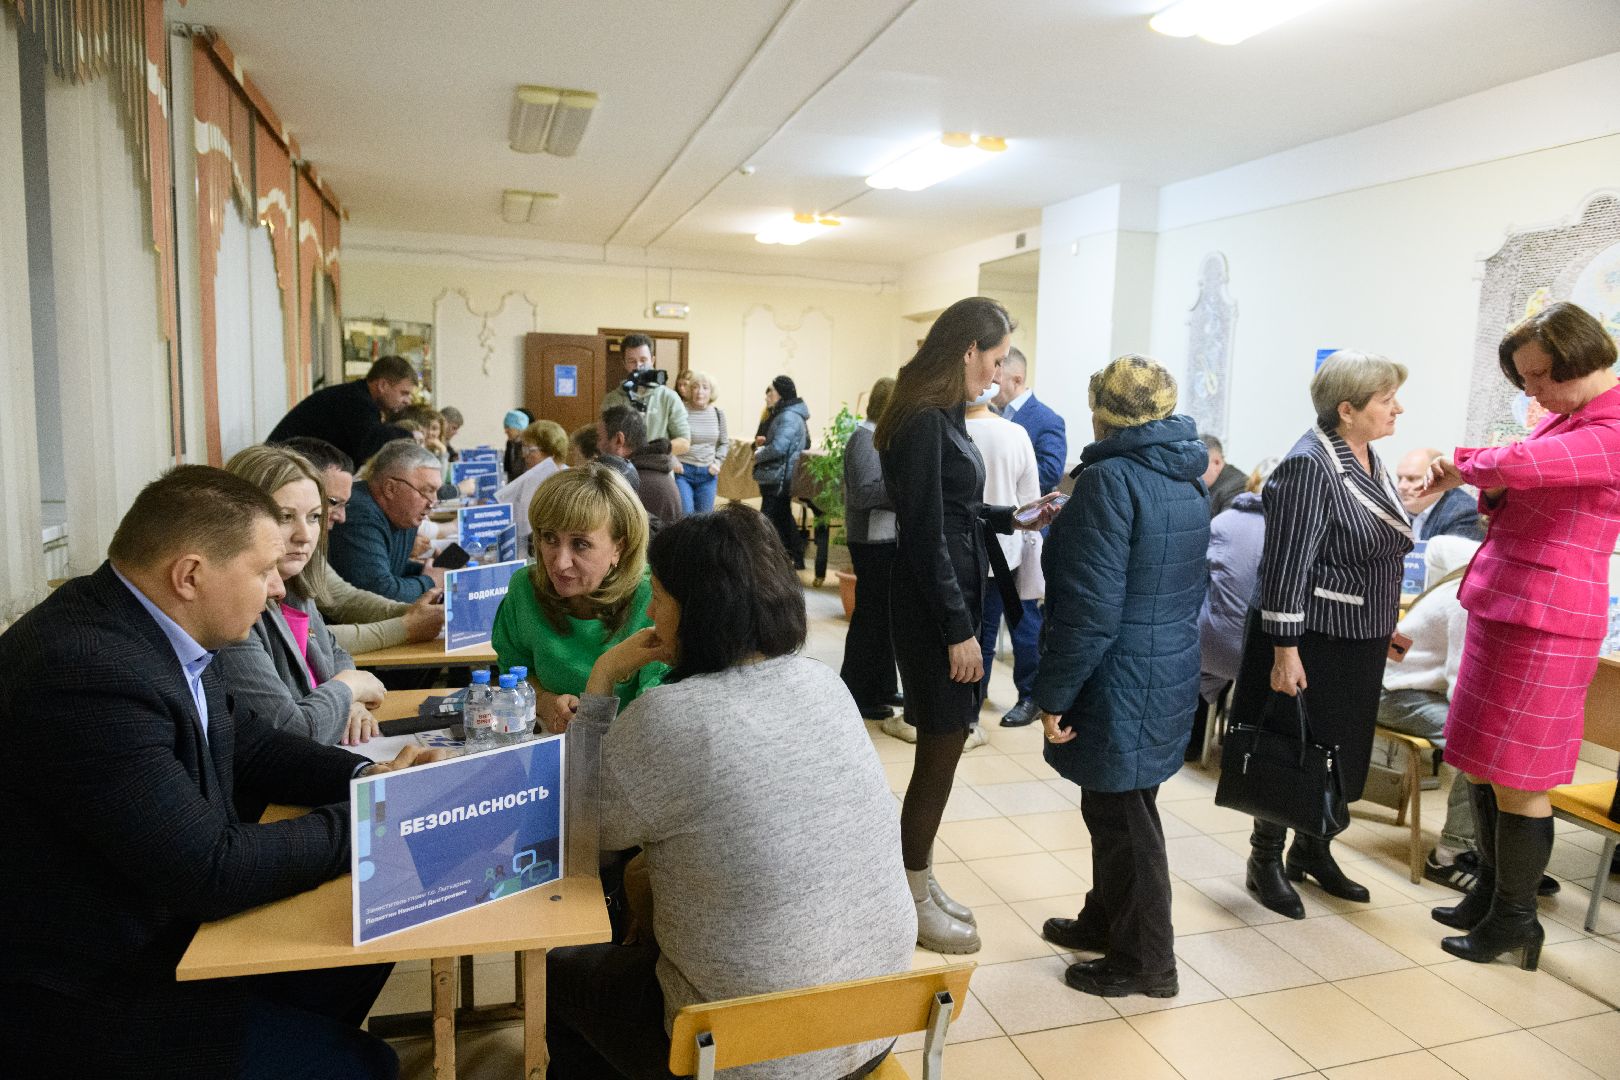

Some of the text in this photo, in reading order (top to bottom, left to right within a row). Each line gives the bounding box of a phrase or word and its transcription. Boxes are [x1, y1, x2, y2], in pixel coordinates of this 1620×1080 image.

[468, 586, 509, 601] ВОДОКАНА
[400, 786, 549, 836] БЕЗОПАСНОСТЬ
[366, 899, 407, 915] Заместитель
[398, 901, 427, 915] Николай
[427, 890, 468, 906] Дмитриевич
